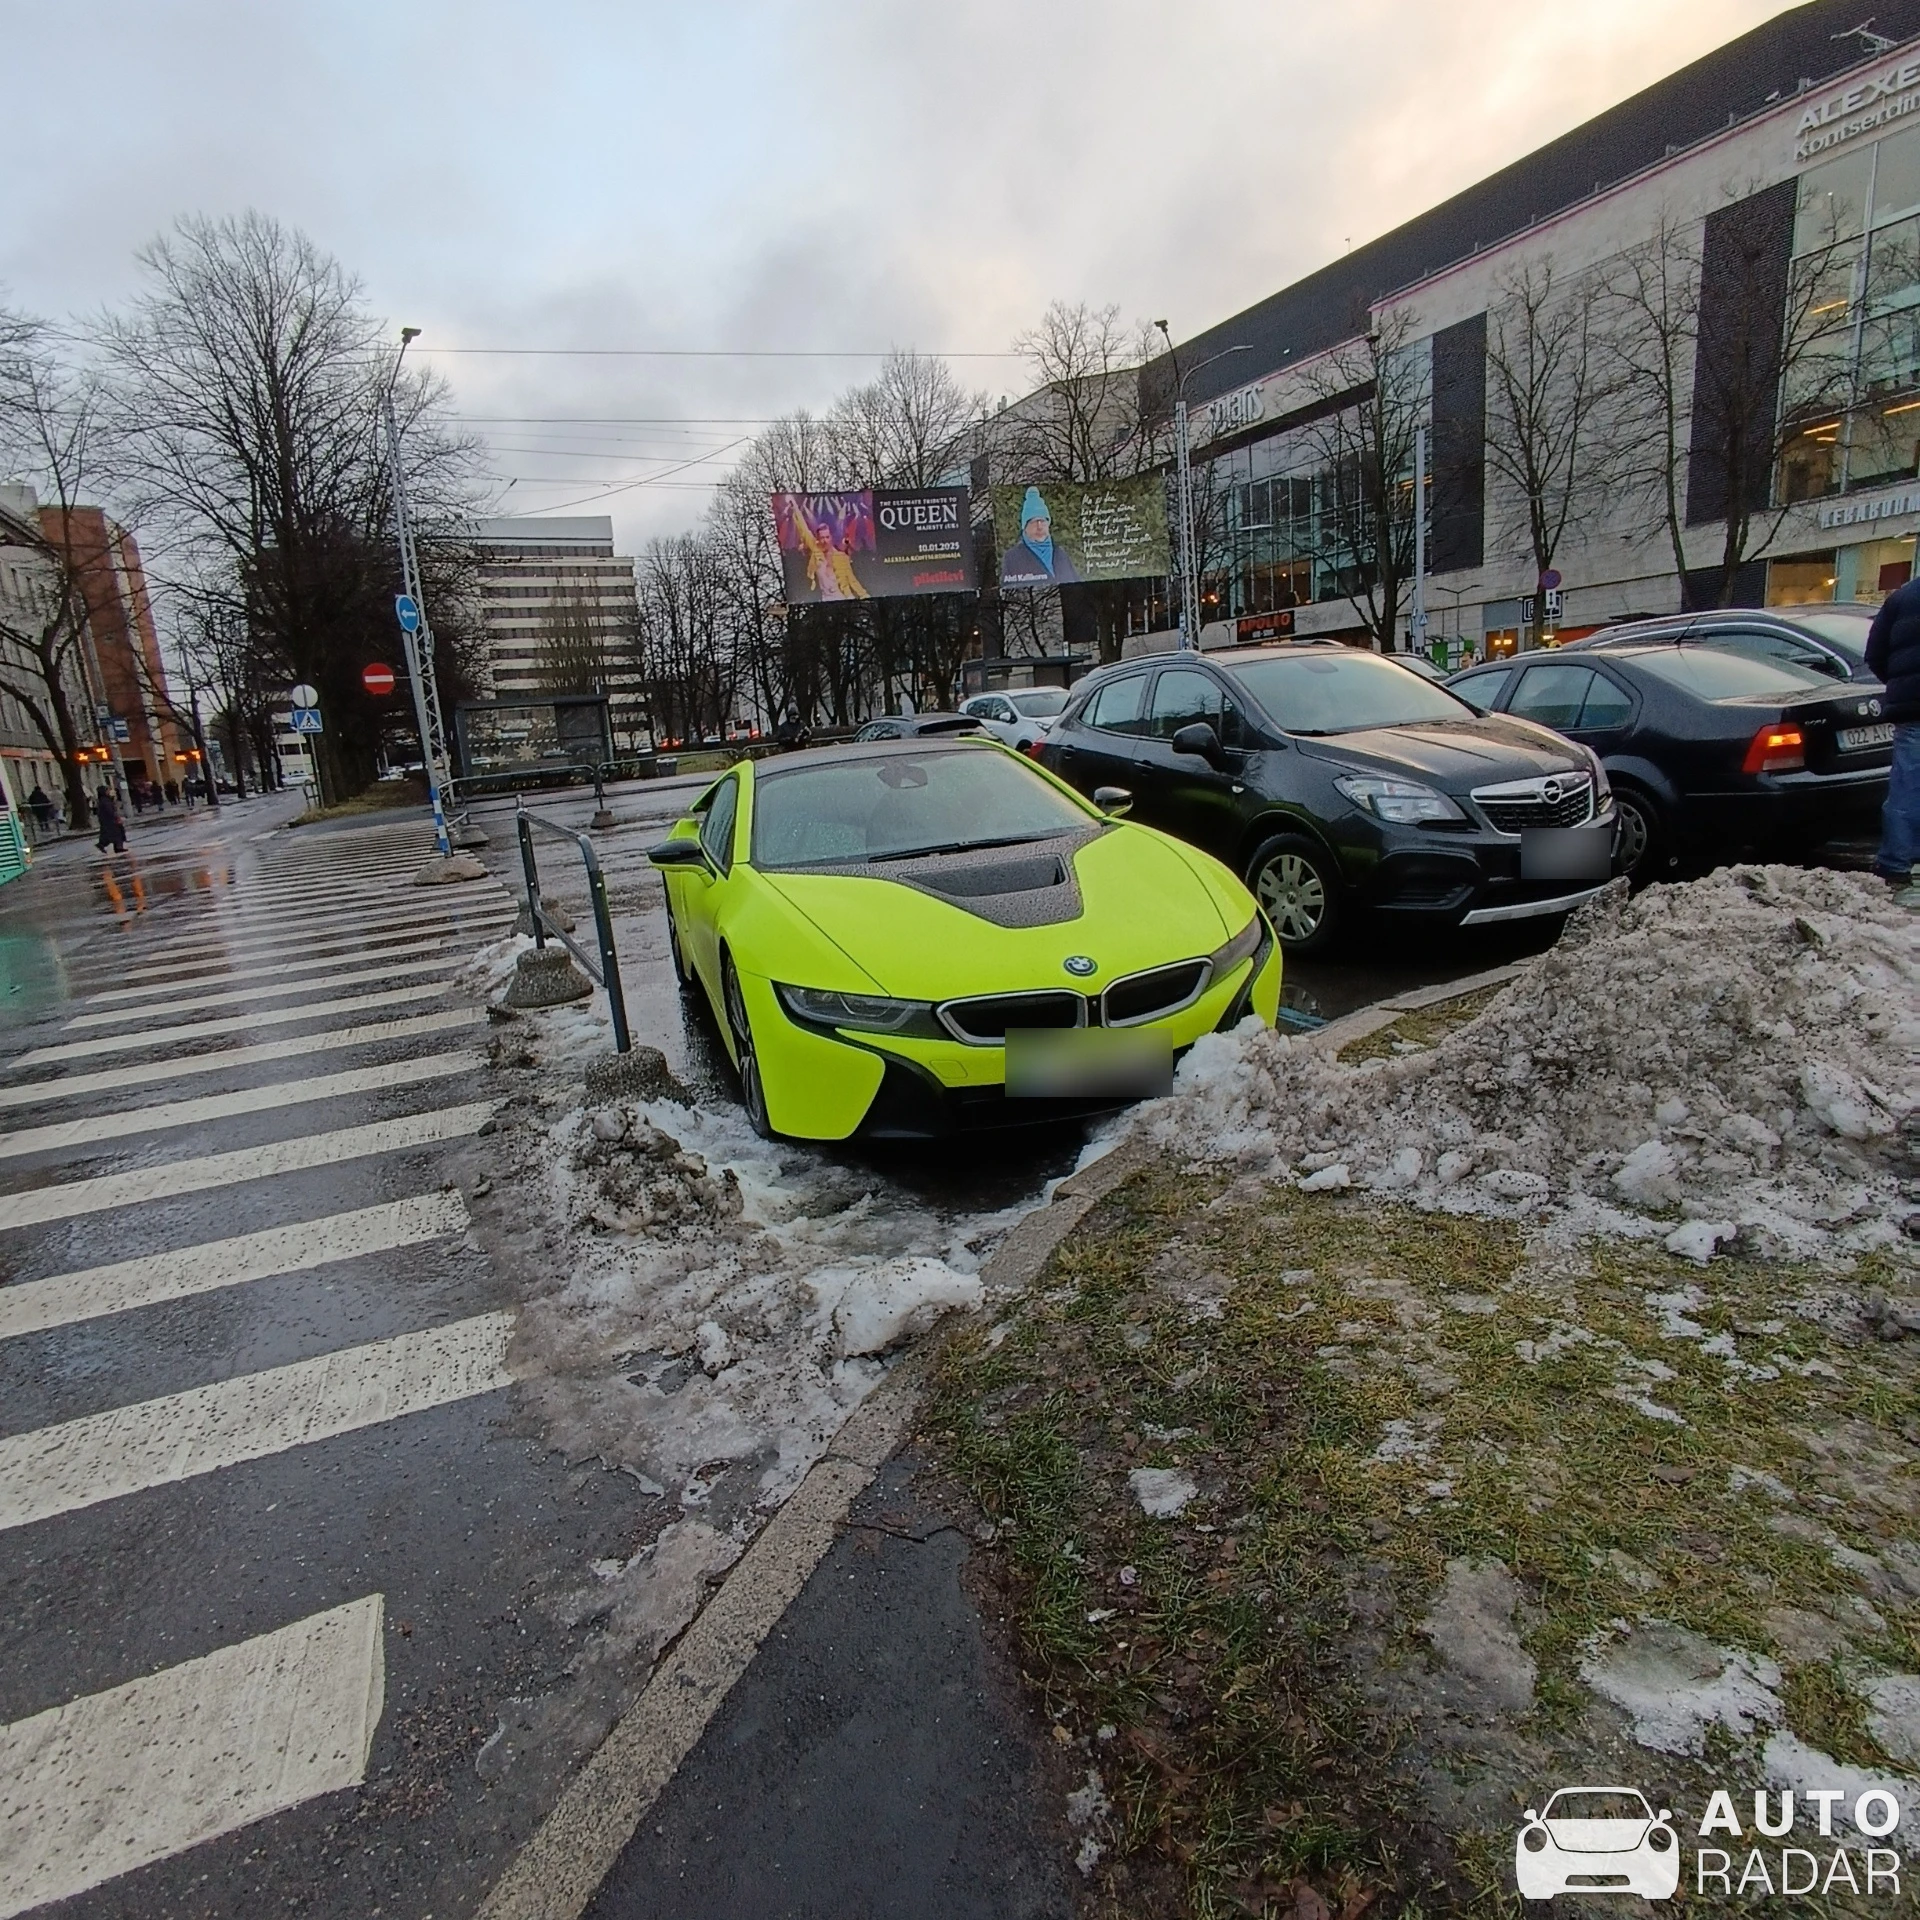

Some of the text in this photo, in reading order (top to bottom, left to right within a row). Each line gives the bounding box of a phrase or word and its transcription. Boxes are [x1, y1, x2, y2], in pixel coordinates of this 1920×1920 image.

[1795, 60, 1920, 138] ALEXE
[880, 504, 957, 530] QUEEN
[916, 523, 943, 531] MAJESTY
[918, 541, 960, 552] 10.01.2025
[1239, 613, 1291, 633] APOLLO
[1847, 728, 1869, 745] 022
